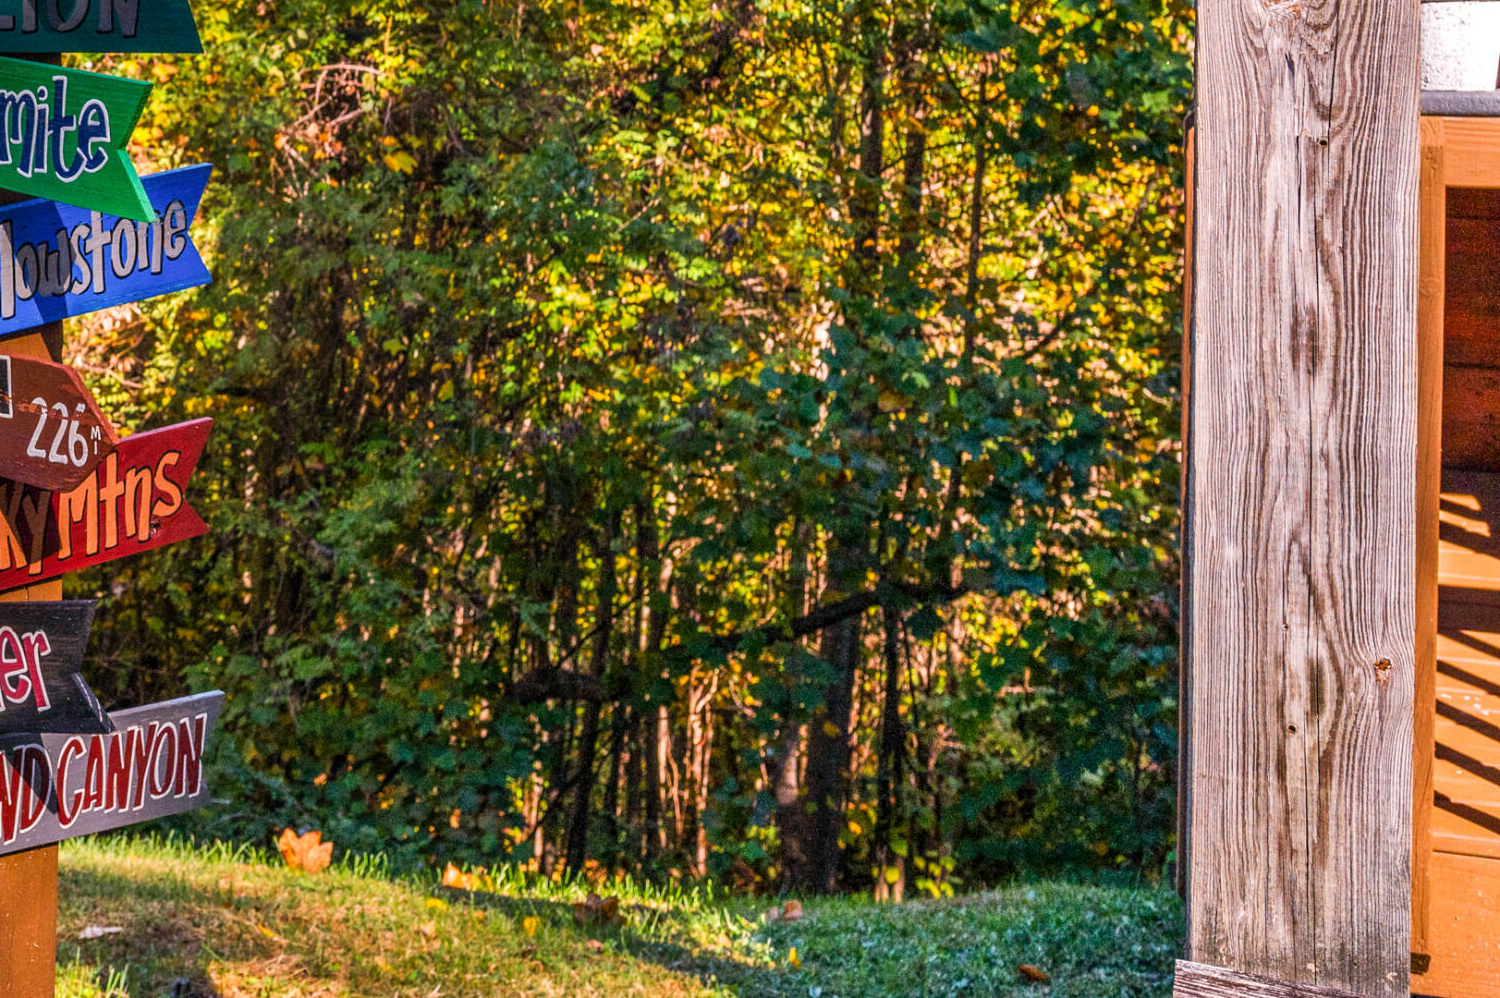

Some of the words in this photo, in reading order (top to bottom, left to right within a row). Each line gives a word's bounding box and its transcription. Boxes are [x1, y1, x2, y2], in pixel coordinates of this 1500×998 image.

[26, 396, 89, 468] 226
[57, 449, 184, 561] Mtns
[56, 712, 208, 830] CANYON
